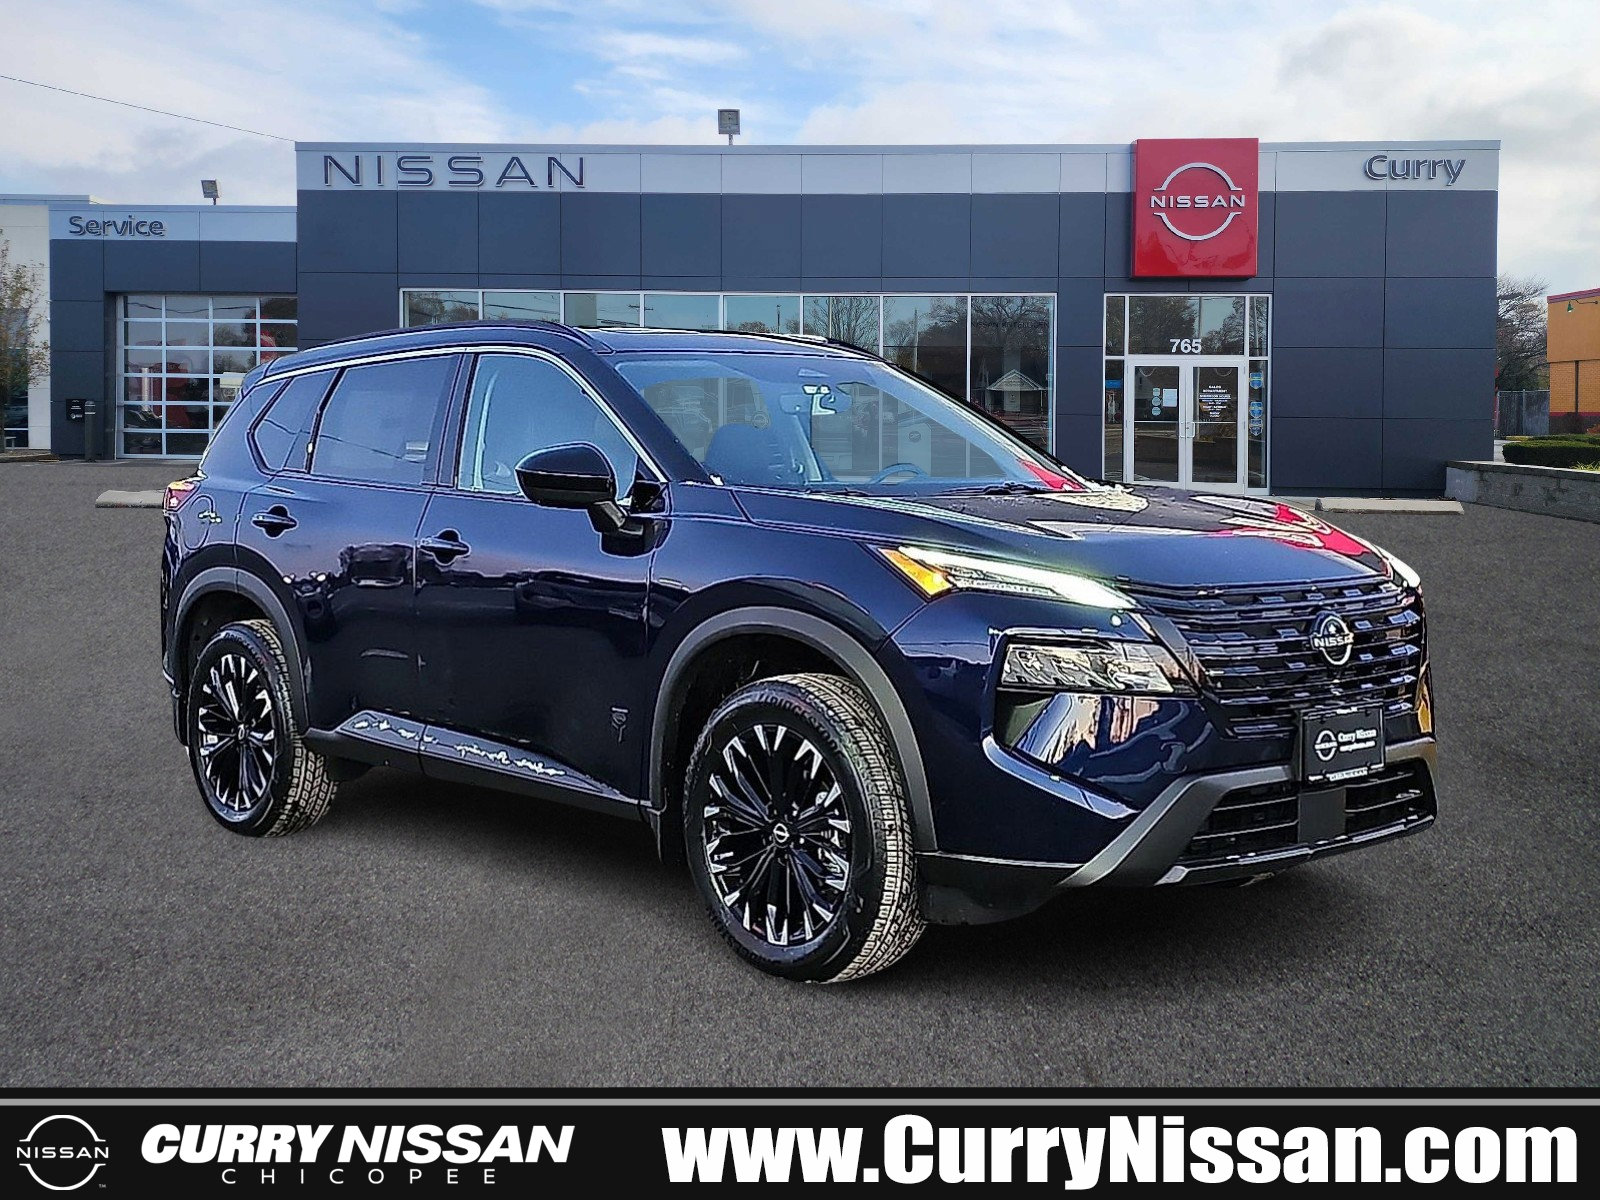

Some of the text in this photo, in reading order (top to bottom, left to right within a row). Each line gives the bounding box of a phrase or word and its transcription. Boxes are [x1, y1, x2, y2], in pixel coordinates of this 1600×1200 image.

[323, 155, 585, 188] NISSAN
[1364, 154, 1467, 187] Curry
[1150, 194, 1246, 209] NISSAN
[68, 214, 166, 236] Service
[1169, 338, 1202, 354] 765
